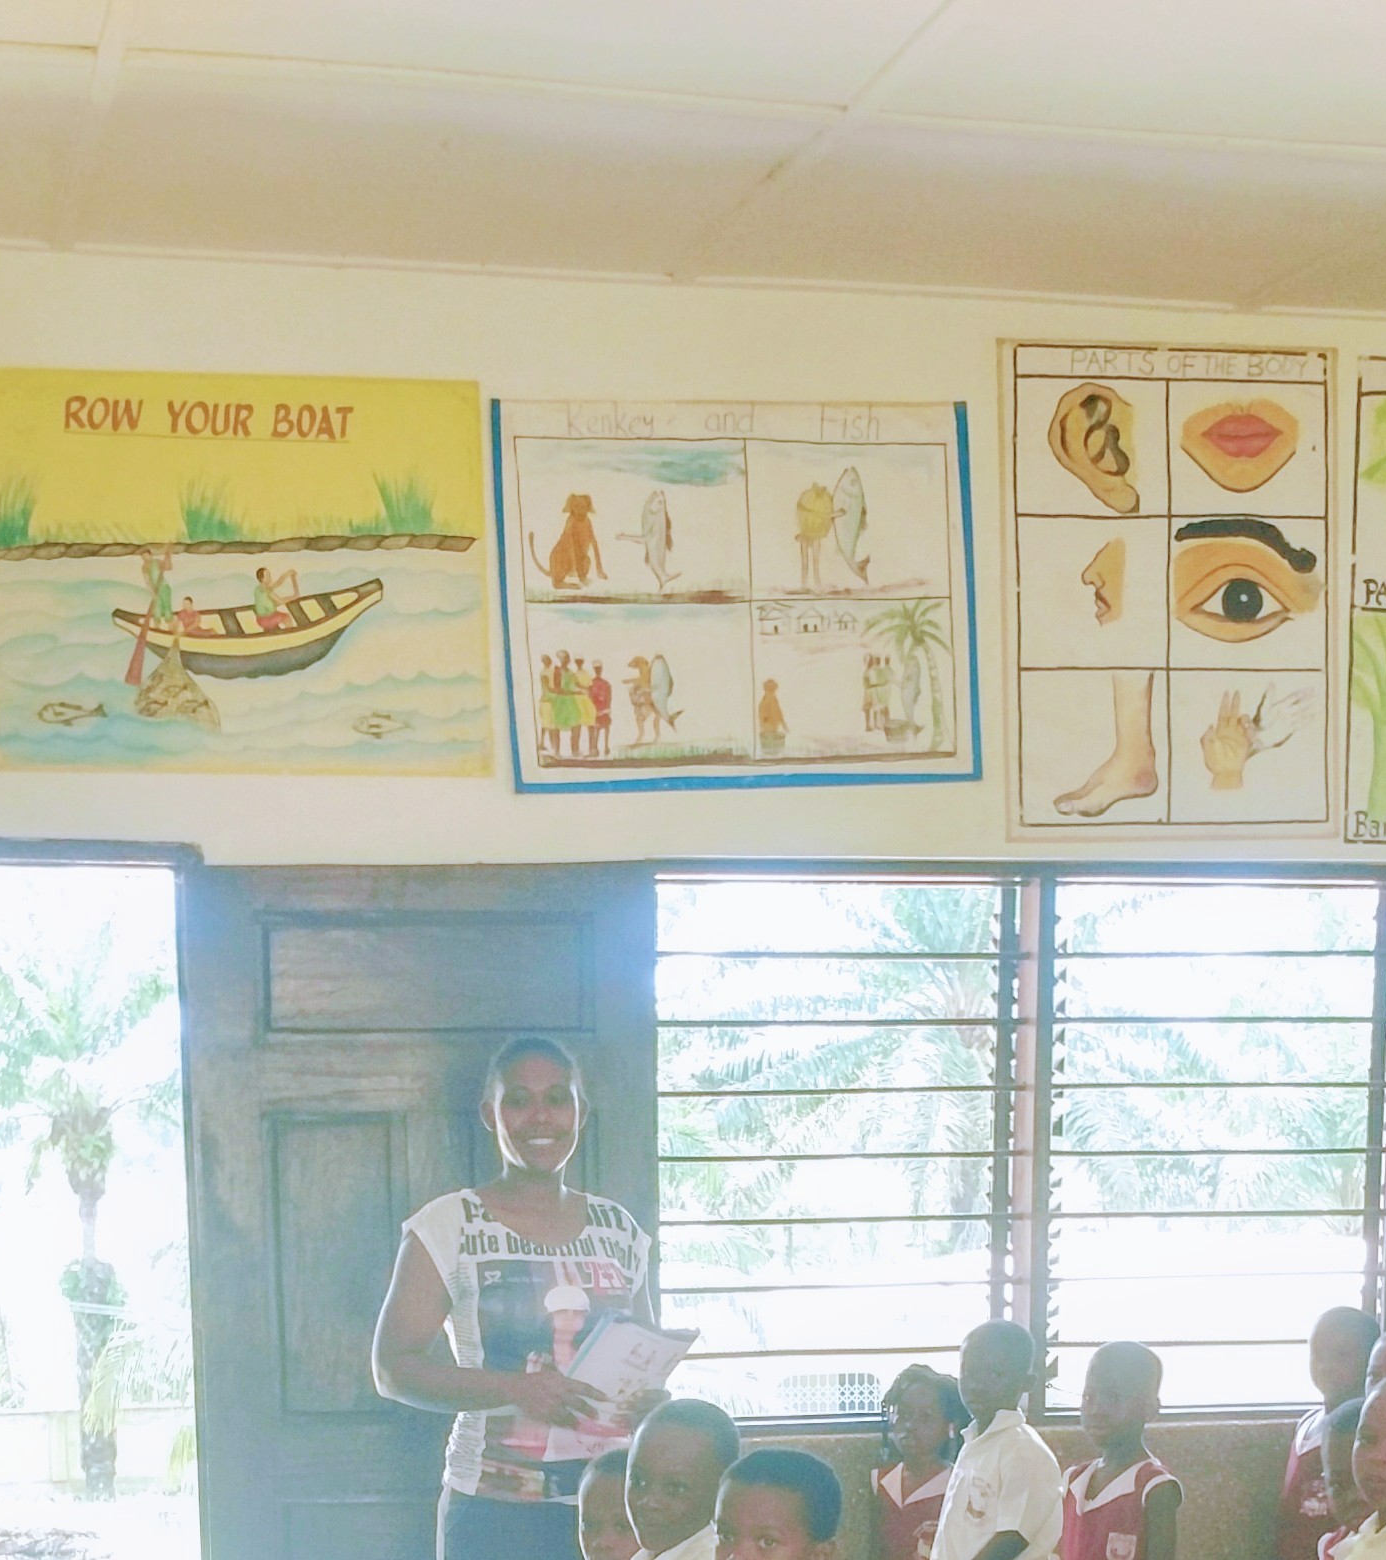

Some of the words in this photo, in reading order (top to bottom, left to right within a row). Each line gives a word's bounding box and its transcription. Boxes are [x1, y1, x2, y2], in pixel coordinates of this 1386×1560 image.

[1071, 351, 1154, 376] PARTS
[1167, 355, 1197, 378] OF
[1205, 356, 1237, 377] THE
[1247, 356, 1309, 378] BODY
[63, 395, 143, 431] ROW
[166, 399, 254, 438] YOUR
[270, 402, 354, 441] BOAT
[704, 400, 754, 434] and
[819, 402, 881, 441] Fish
